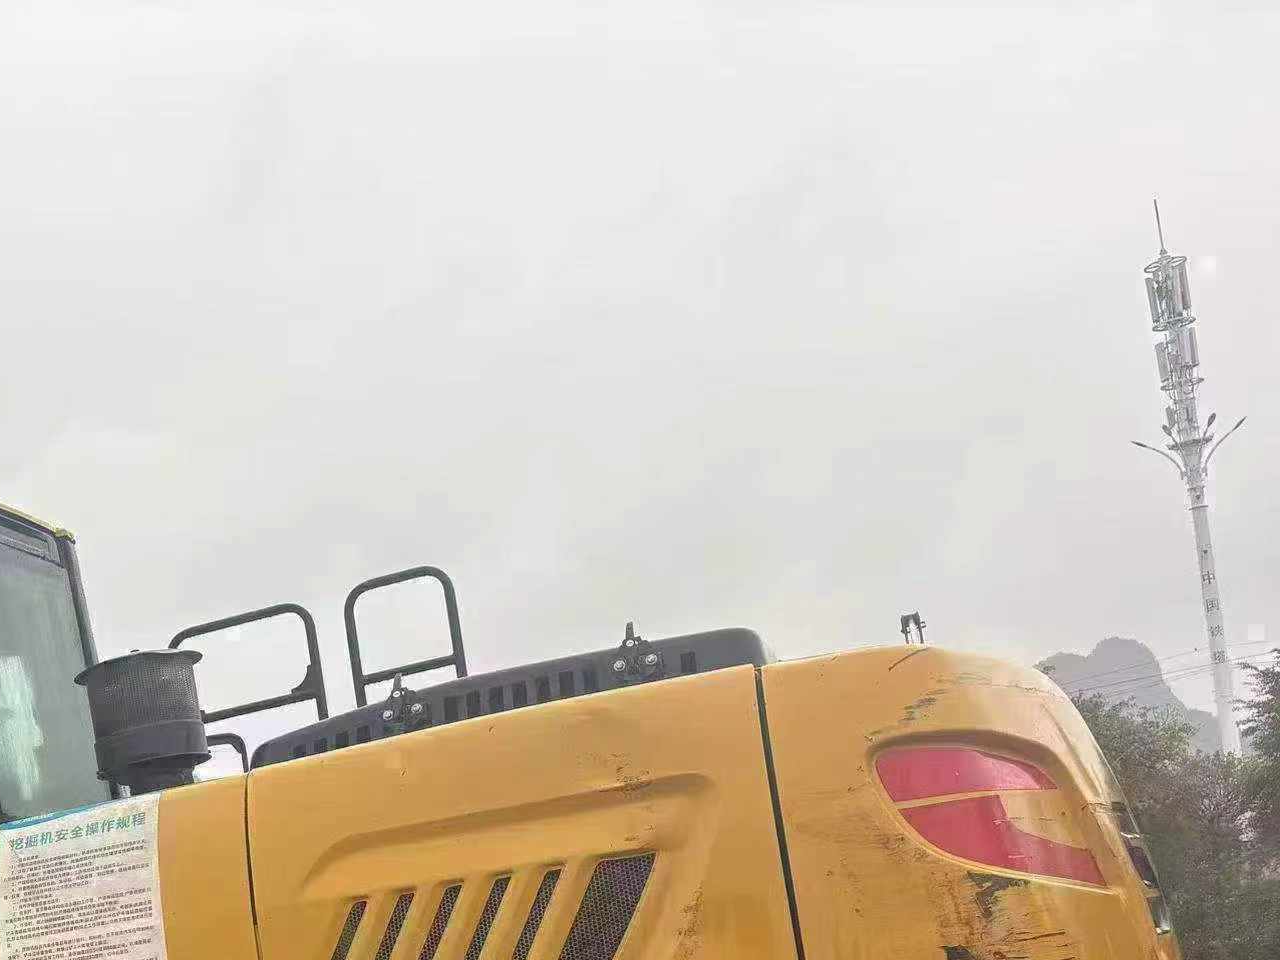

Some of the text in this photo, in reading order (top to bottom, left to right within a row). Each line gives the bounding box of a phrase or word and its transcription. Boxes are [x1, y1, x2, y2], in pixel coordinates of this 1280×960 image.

[9, 812, 146, 850] 挖掘机安全操作规程
